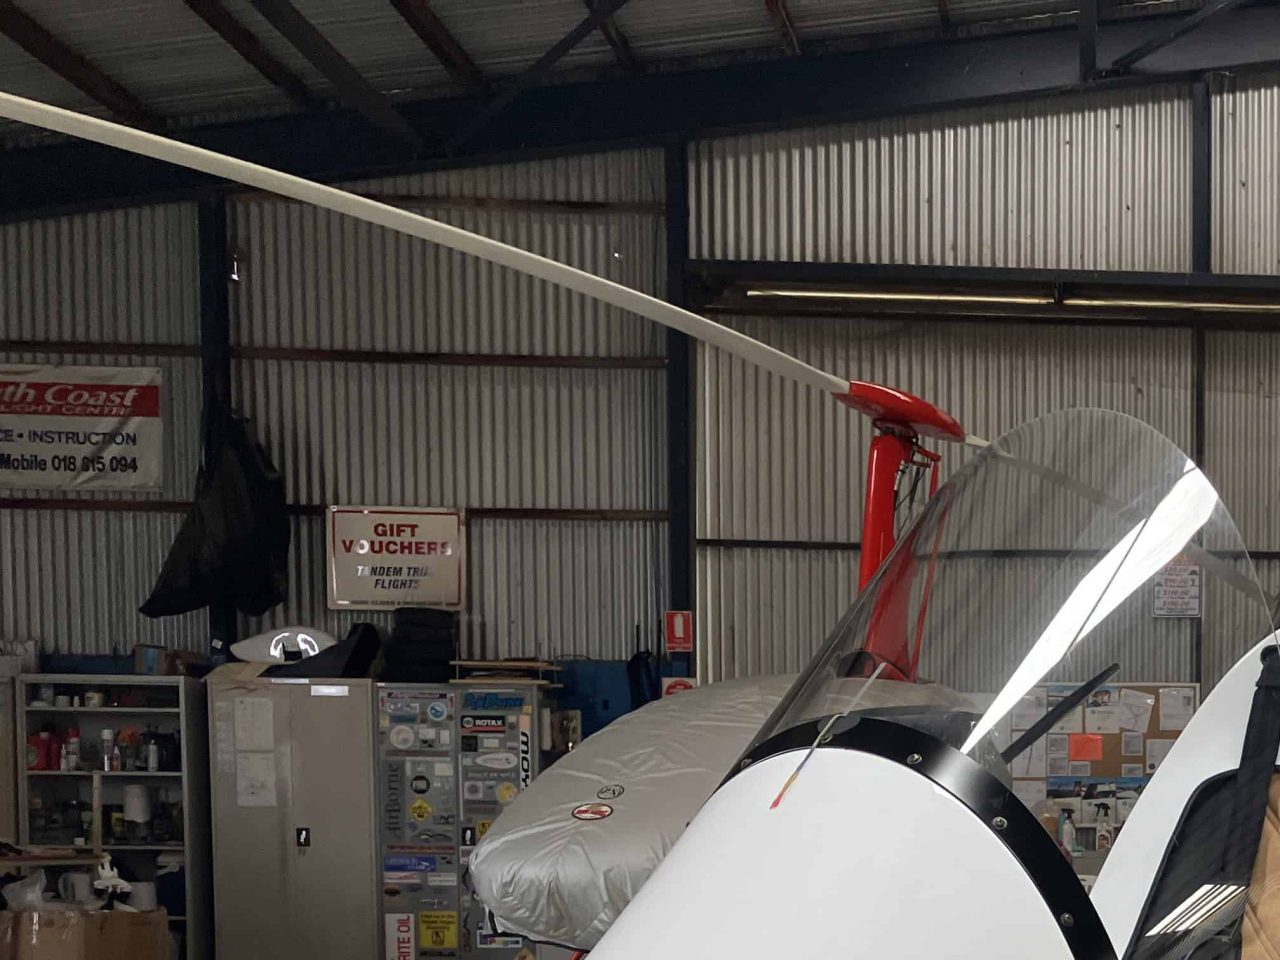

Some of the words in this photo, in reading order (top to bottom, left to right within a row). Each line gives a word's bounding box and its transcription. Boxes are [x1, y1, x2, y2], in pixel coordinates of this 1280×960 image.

[44, 385, 138, 406] Coast
[28, 430, 137, 446] INSTRUCTON
[0, 453, 47, 471] Mobile
[51, 455, 77, 471] 018
[109, 456, 138, 472] 094
[374, 523, 418, 537] GIFT
[342, 539, 452, 556] VOUCHERS
[357, 565, 402, 577] TANDEM
[475, 719, 503, 727] ROTAX
[397, 915, 410, 933] OIL
